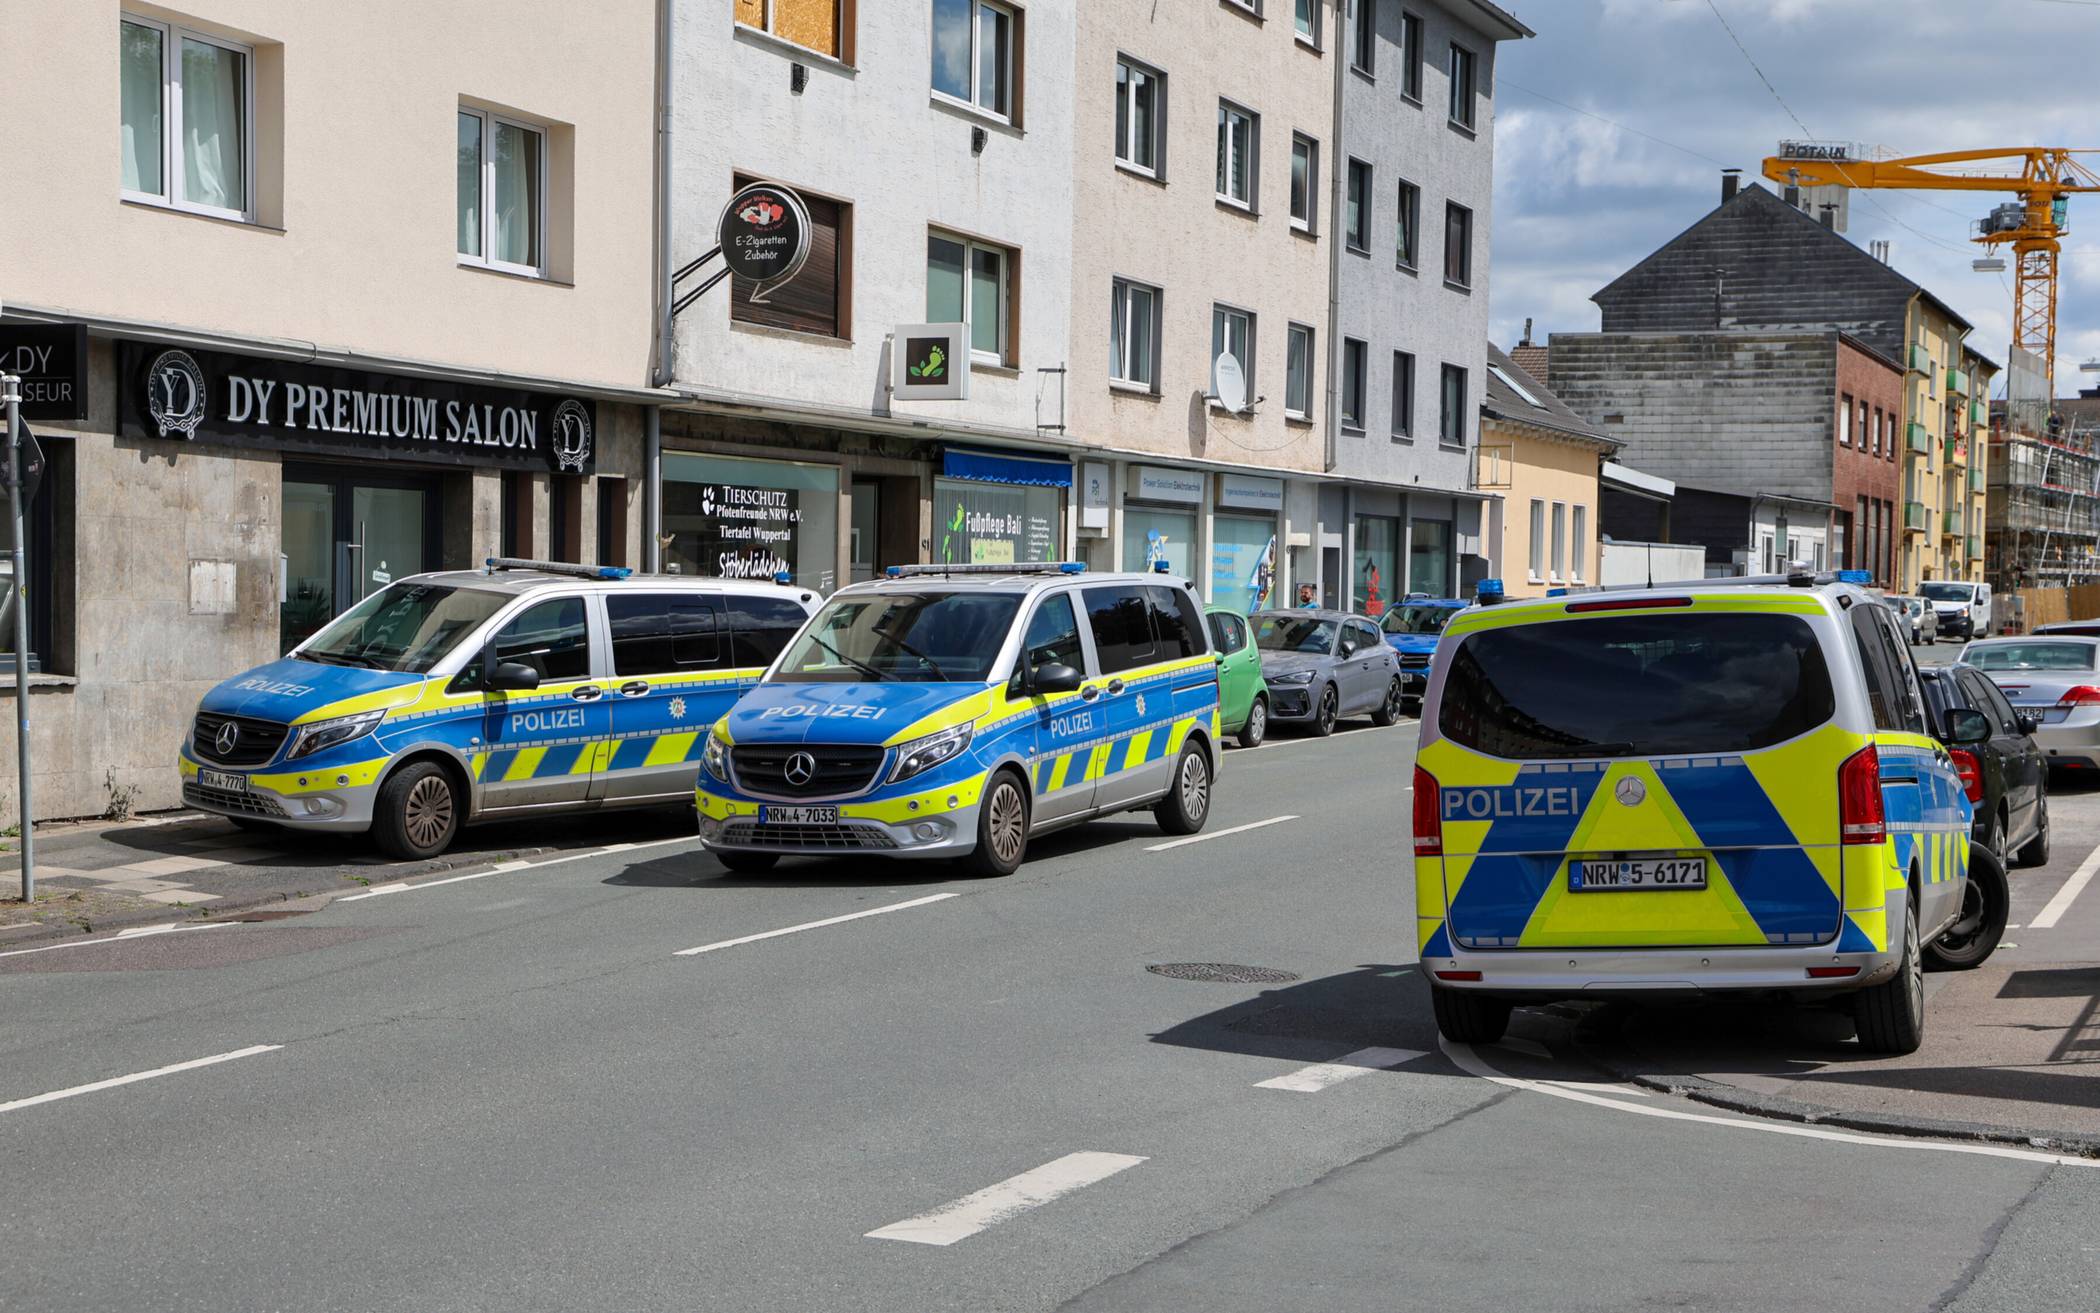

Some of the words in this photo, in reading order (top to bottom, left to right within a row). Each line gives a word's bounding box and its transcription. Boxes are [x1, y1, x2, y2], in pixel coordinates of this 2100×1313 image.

[1785, 143, 1846, 159] POTAIN
[735, 234, 788, 248] E-Zigaretten
[744, 249, 779, 261] Zubehör
[16, 345, 53, 374] DY
[19, 382, 73, 402] ISEUR
[227, 375, 276, 424] DY
[285, 382, 438, 440] PREMIUM
[446, 400, 537, 449] SALON
[722, 486, 787, 507] TIERSCHUTZ
[716, 504, 768, 520] Pfotenfreunde
[768, 507, 789, 521] NRW
[789, 509, 804, 522] e.V.
[966, 511, 1005, 538] Fußpflege
[1006, 513, 1022, 536] Bali
[719, 525, 752, 539] Tiertafel
[753, 527, 791, 544] Wuppertal
[235, 679, 315, 697] POLIZEI
[512, 708, 585, 733] POLIZEI
[759, 704, 887, 720] POLIZEI
[1050, 711, 1093, 739] POLIZEI
[203, 771, 215, 785] NRW
[1444, 787, 1579, 818] POLIZEI
[766, 807, 787, 823] NRW
[793, 808, 835, 823] 4-7033
[1582, 863, 1620, 885] NRW
[1631, 862, 1704, 884] 5-6171
